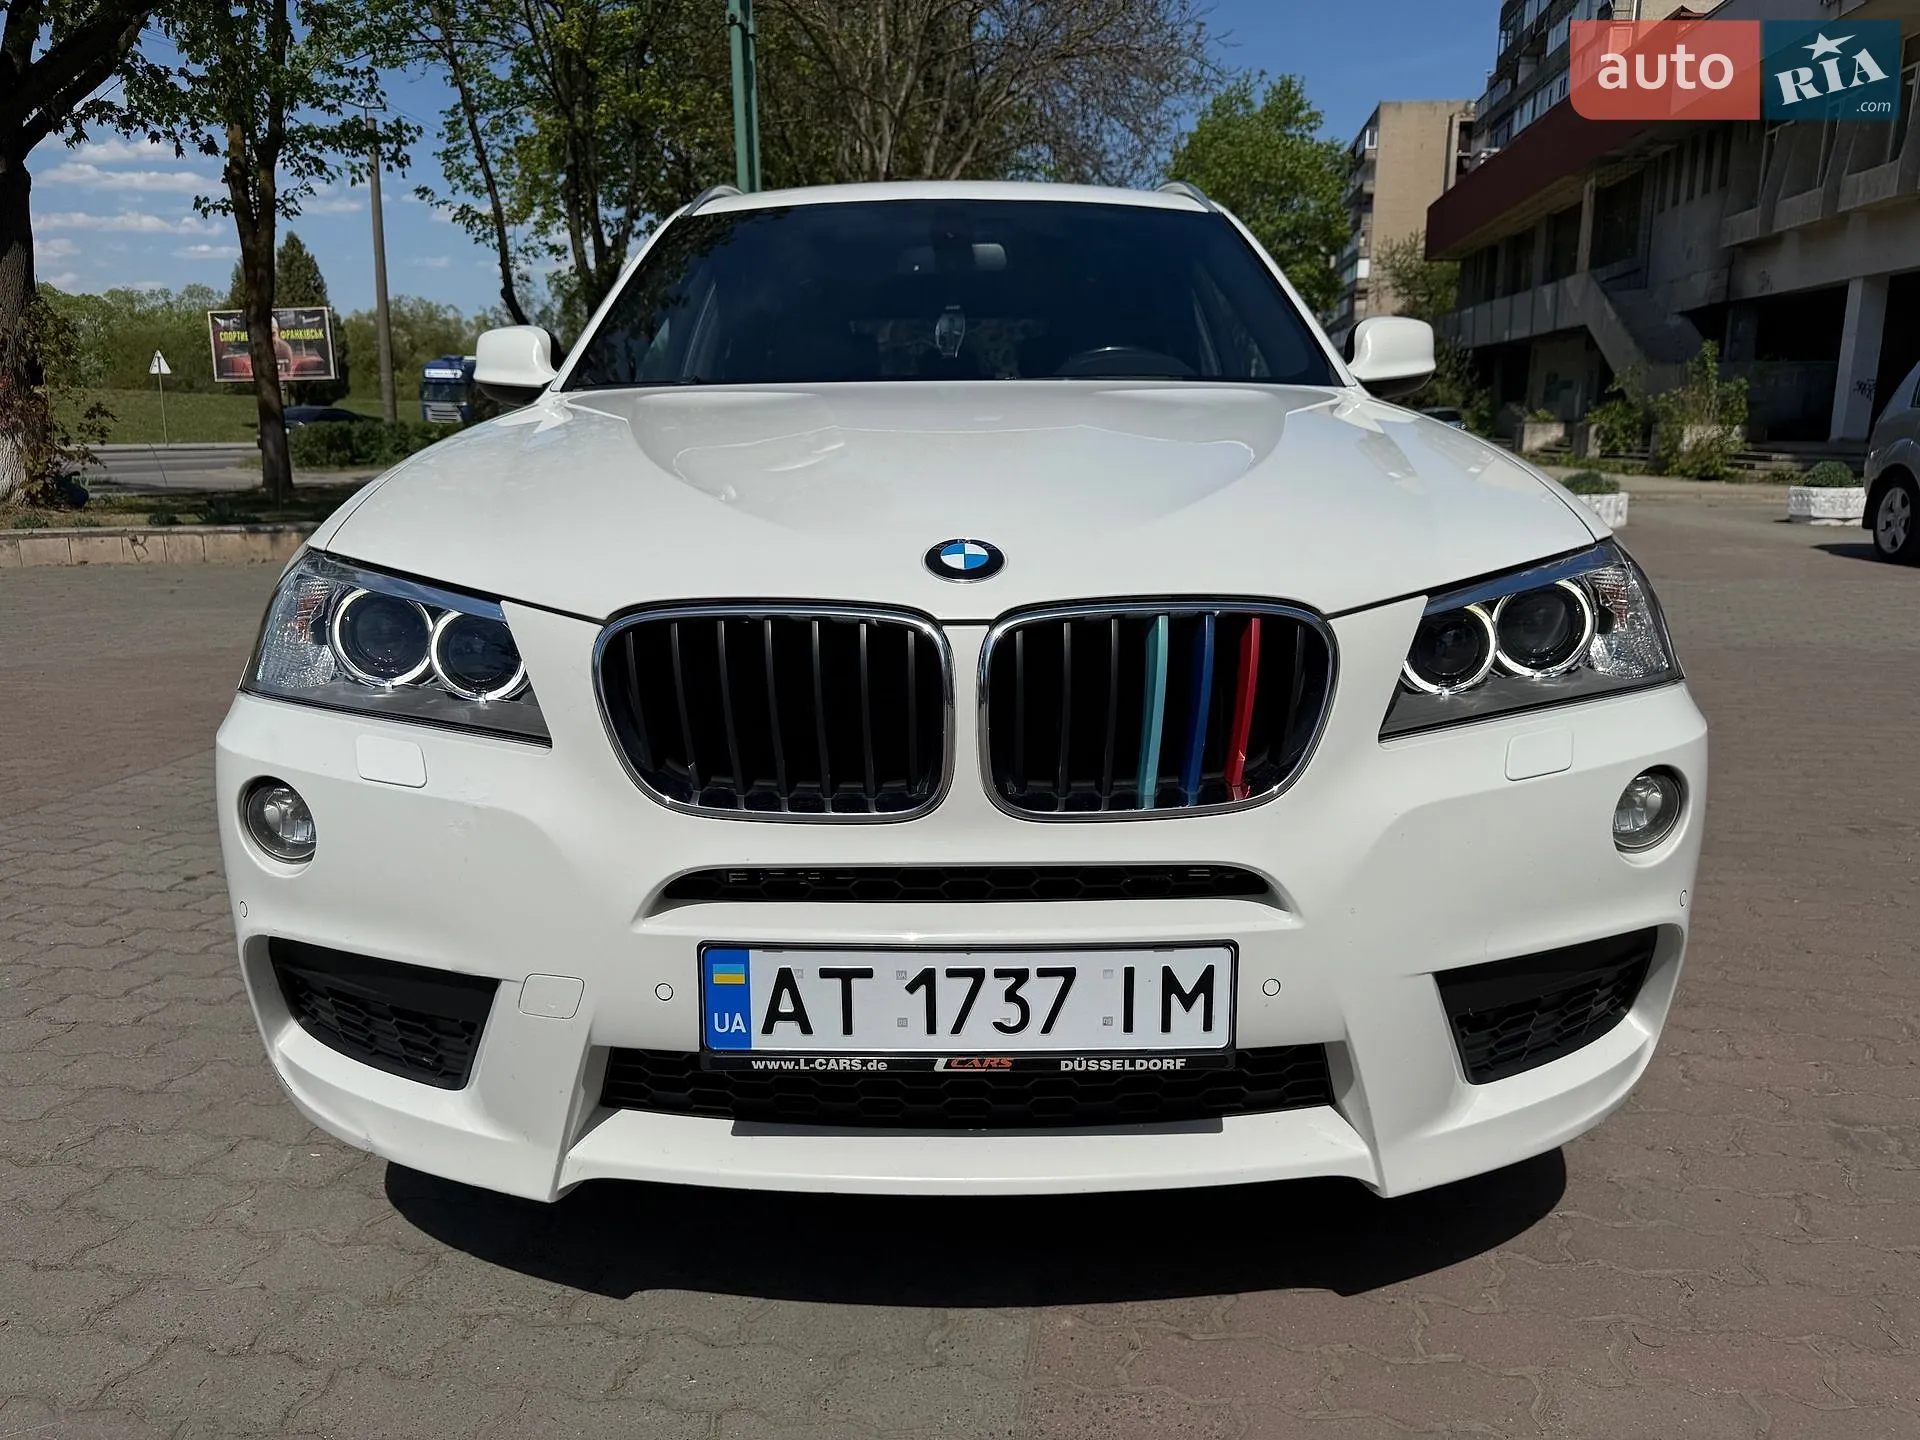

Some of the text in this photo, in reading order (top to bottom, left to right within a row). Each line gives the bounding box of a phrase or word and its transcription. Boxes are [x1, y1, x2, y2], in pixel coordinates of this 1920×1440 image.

[761, 963, 1214, 1035] AT 1737 IM
[714, 1012, 747, 1033] UA
[751, 1058, 888, 1071] www.L-CARS.de
[1060, 1057, 1187, 1071] DÜSSELDORF
